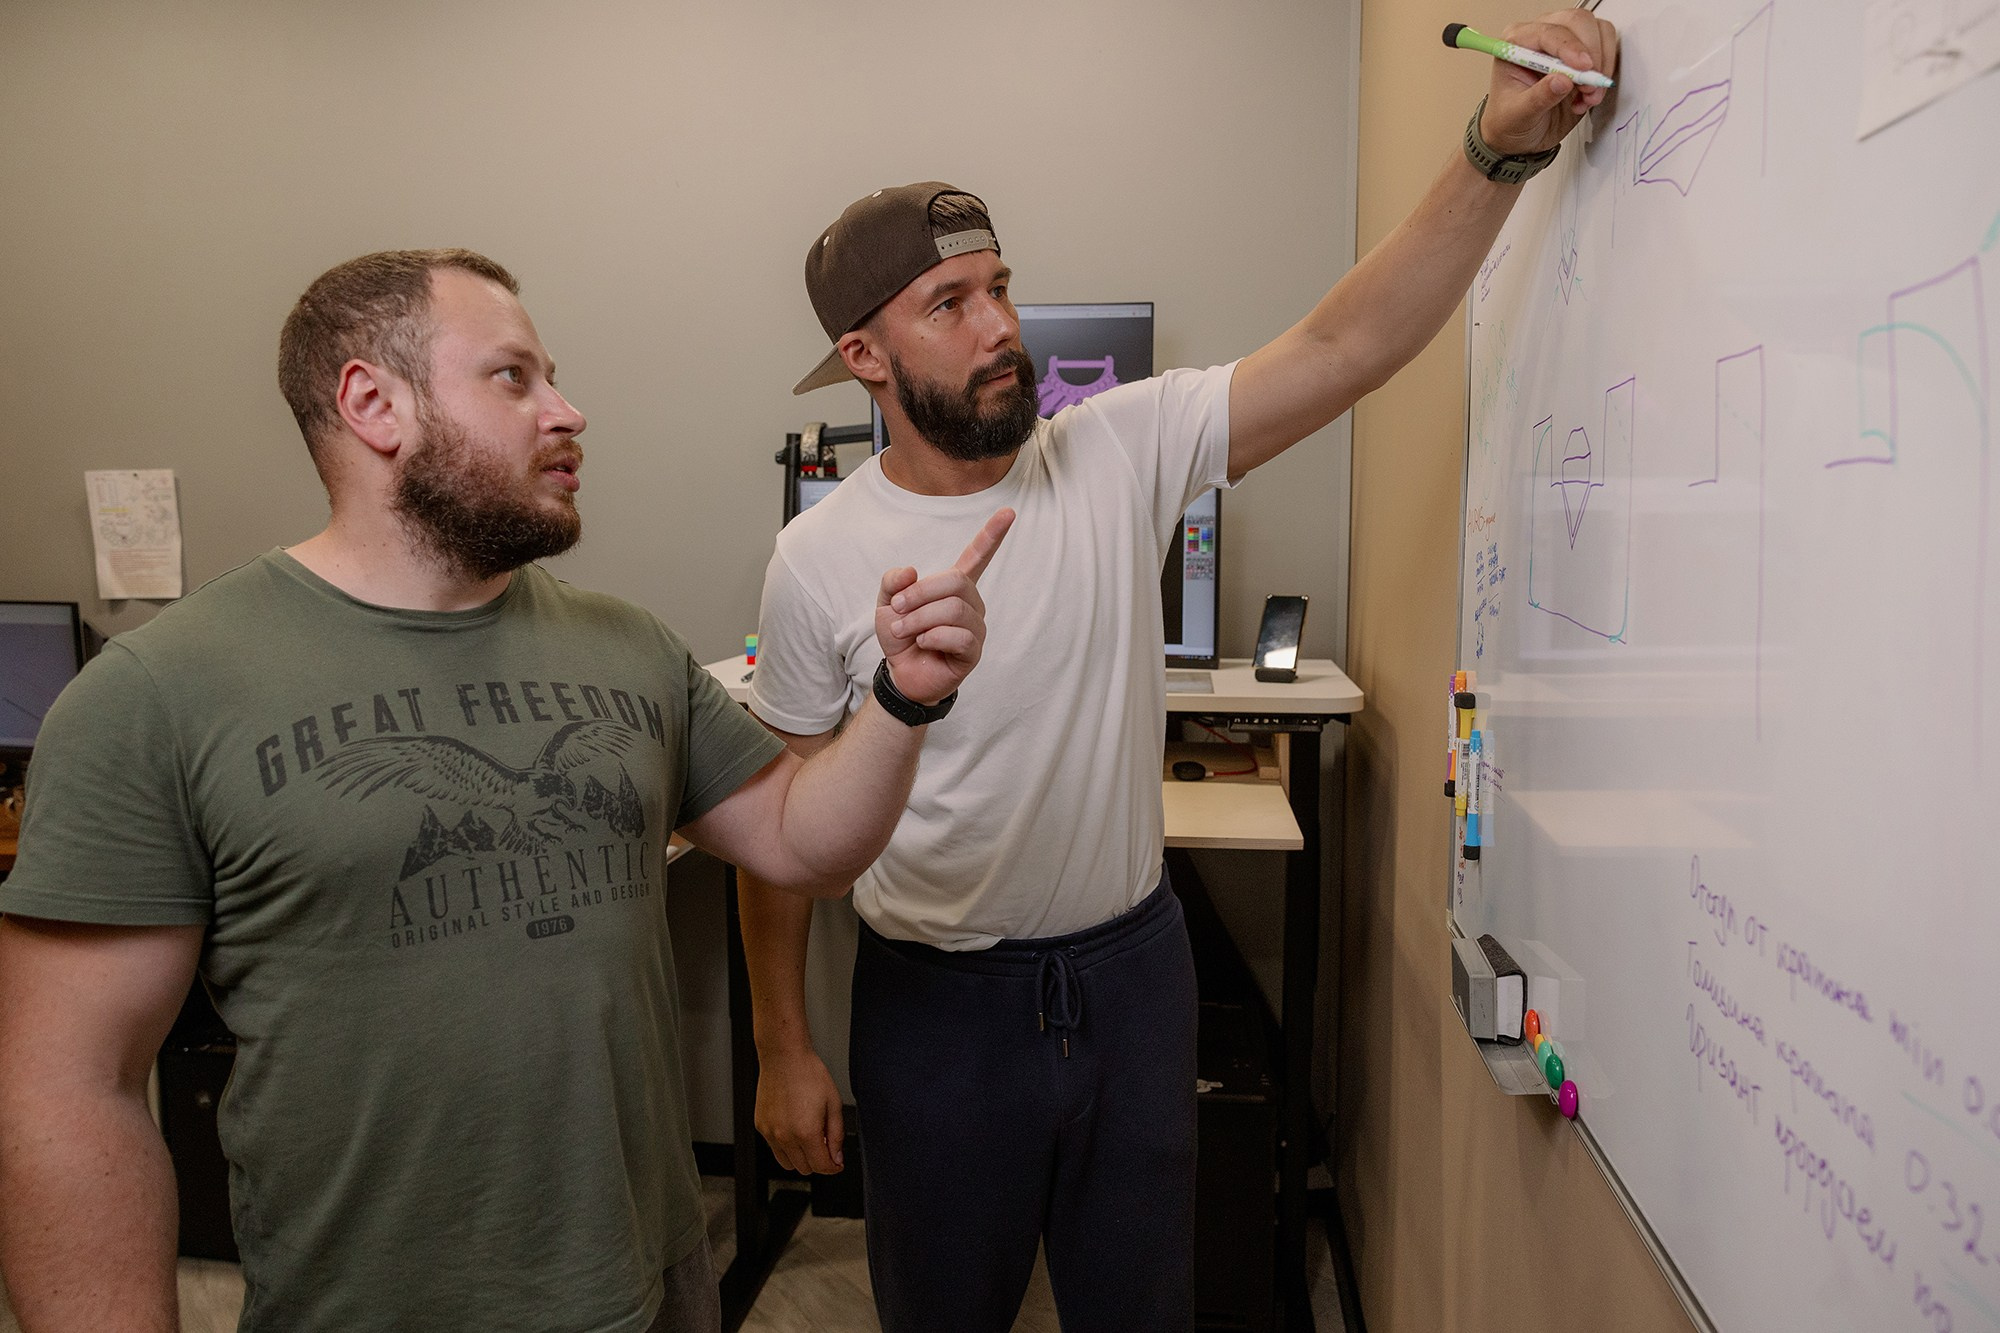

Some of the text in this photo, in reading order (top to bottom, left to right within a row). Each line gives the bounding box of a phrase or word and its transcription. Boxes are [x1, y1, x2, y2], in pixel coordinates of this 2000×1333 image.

[256, 681, 666, 797] GREAT FREEDOM
[390, 841, 649, 929] AUTHENTIC
[391, 911, 490, 949] ORIGINAL
[501, 897, 561, 922] STYLE
[571, 890, 603, 909] AND
[534, 917, 568, 936] 1976
